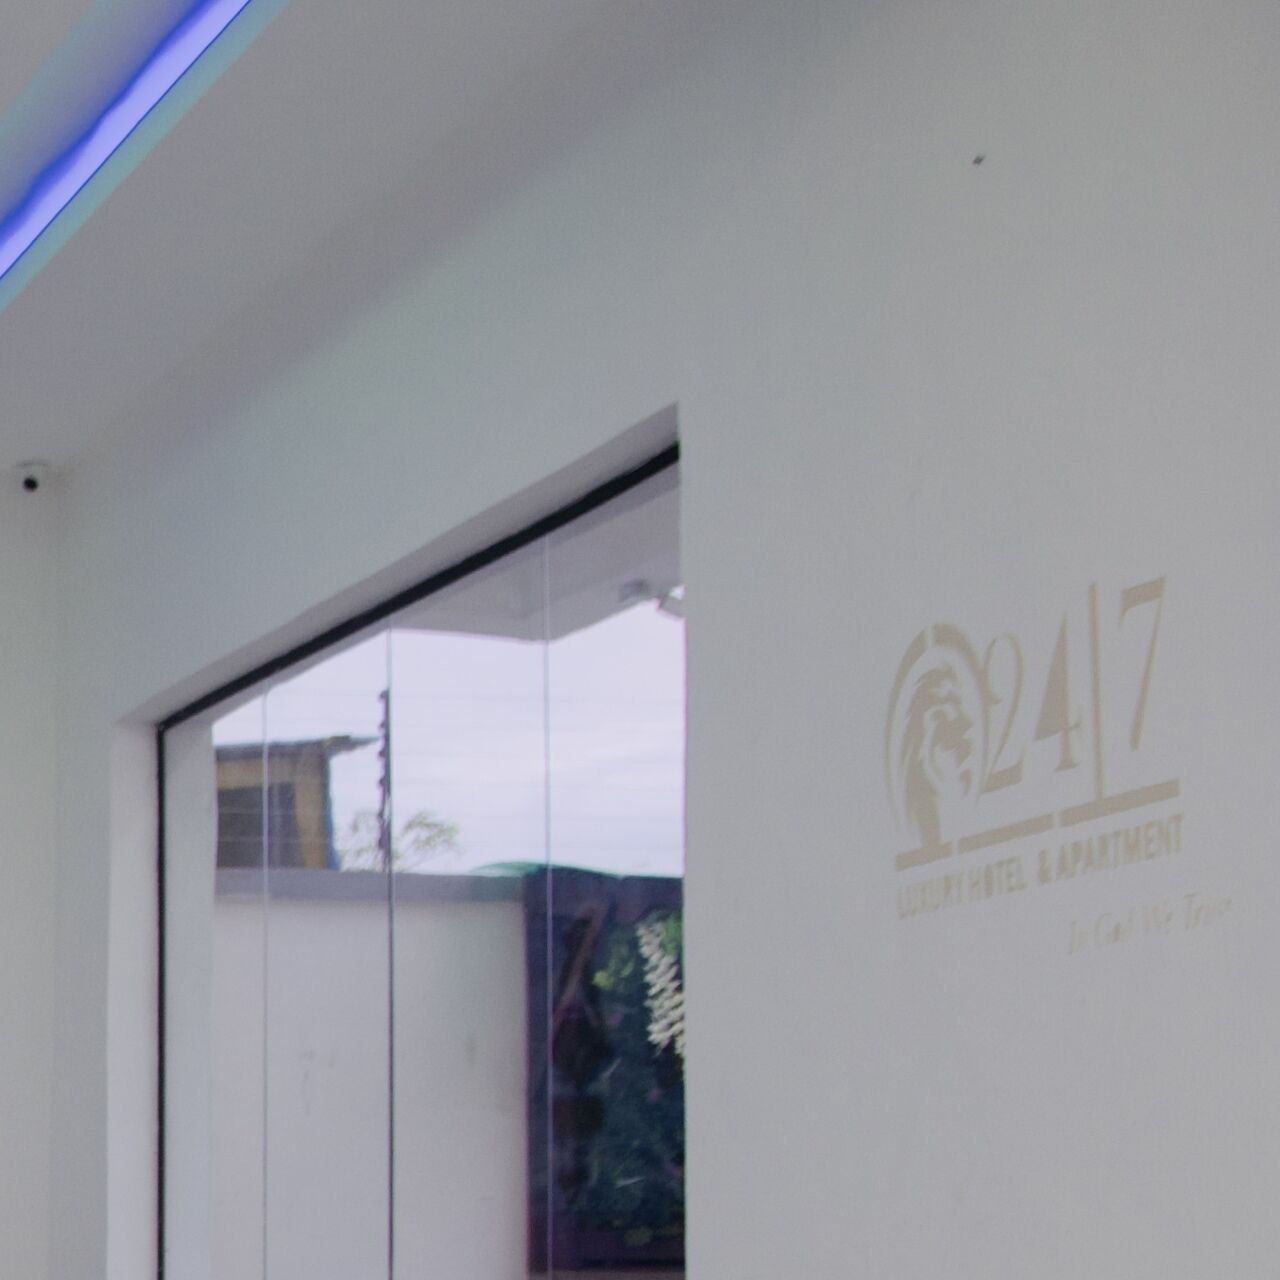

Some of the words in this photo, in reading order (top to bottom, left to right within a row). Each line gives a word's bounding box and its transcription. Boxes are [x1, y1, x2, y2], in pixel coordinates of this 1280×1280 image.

[897, 871, 964, 920] LUXURY
[968, 855, 1028, 900] HOTEL
[1055, 812, 1185, 882] APARTMENT
